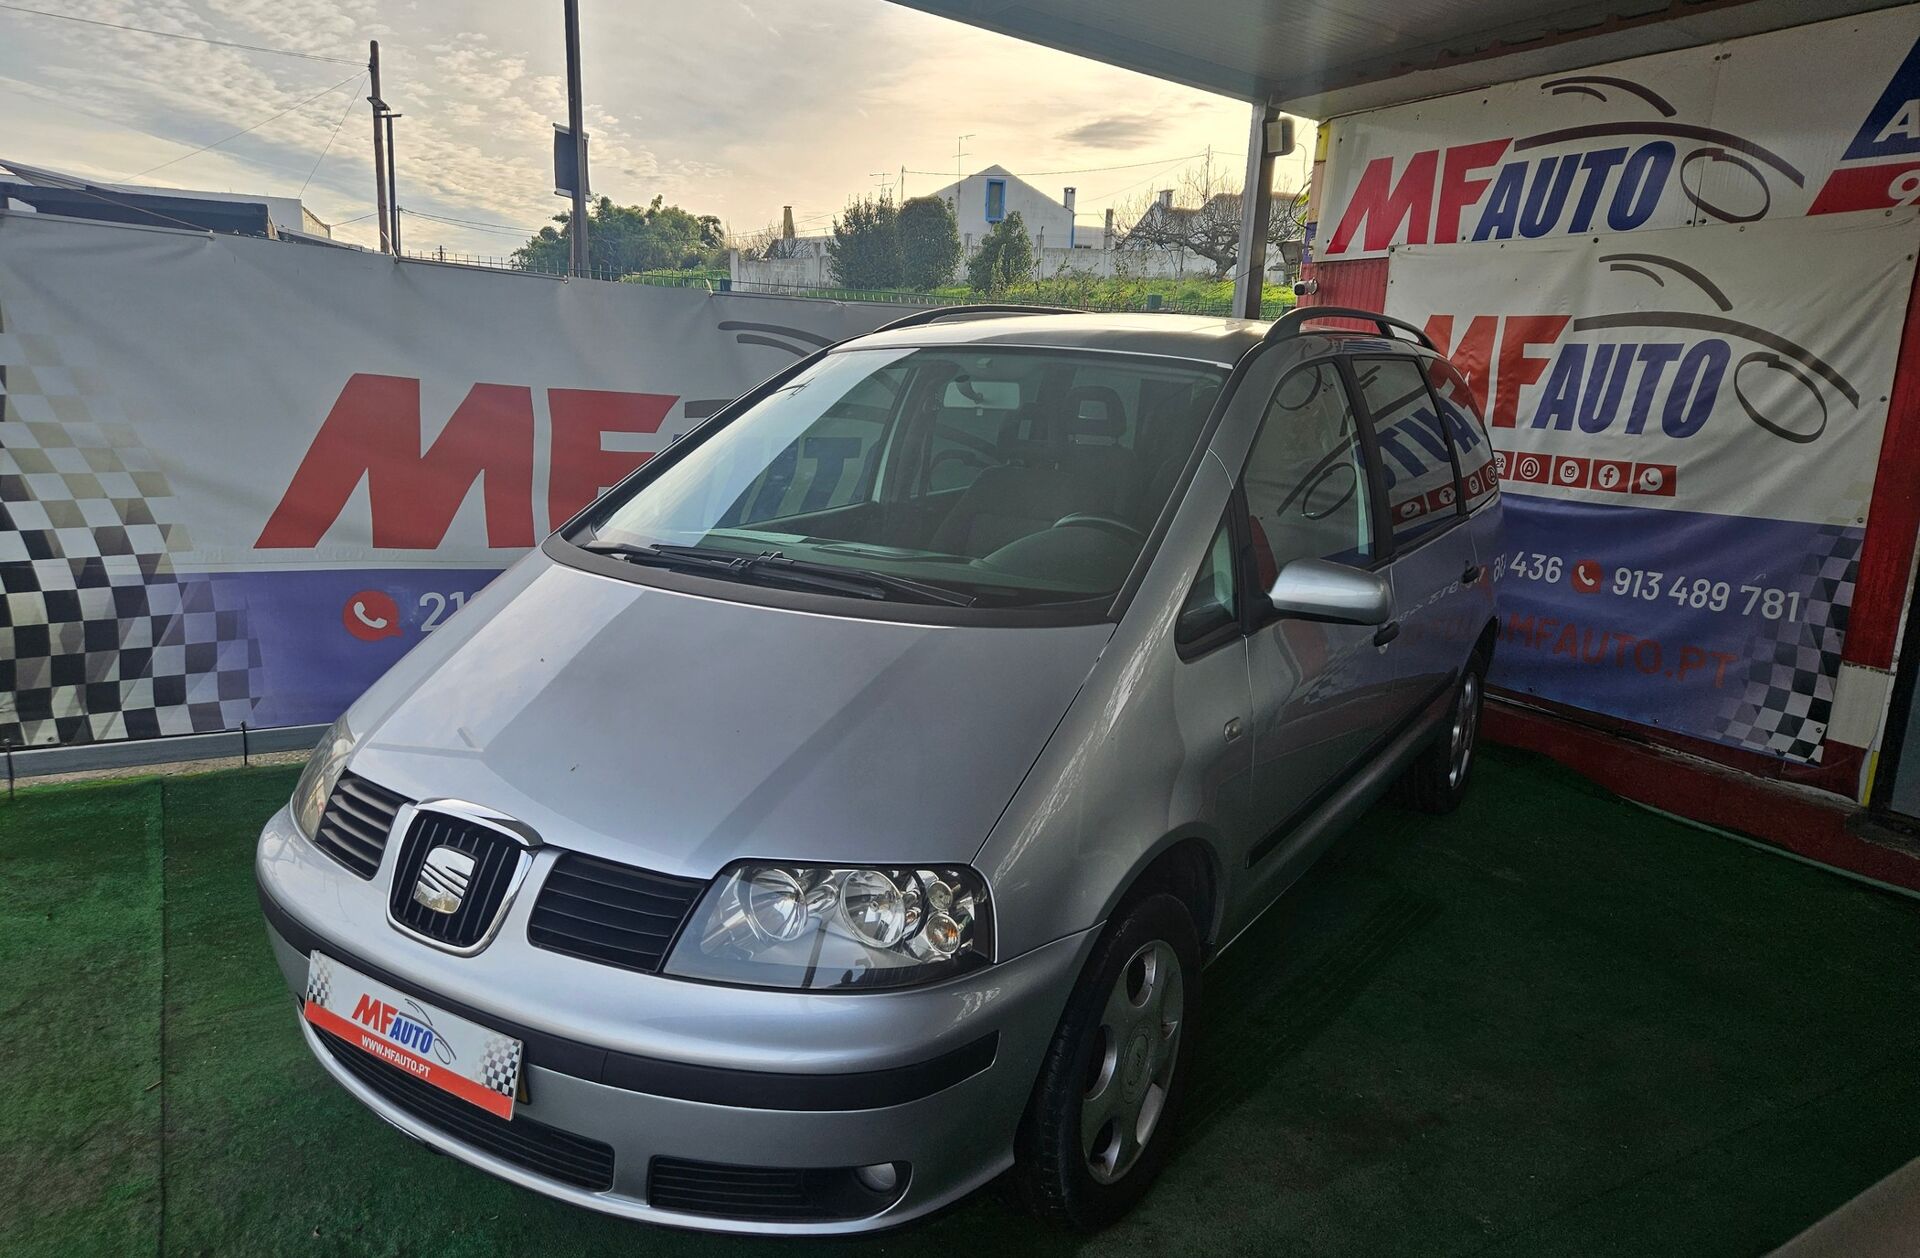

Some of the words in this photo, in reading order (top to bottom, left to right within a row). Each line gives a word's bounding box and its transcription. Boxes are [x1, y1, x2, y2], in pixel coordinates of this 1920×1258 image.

[1510, 551, 1563, 583] 436
[1613, 567, 1664, 601] 913
[1668, 576, 1731, 612] 489
[1740, 584, 1801, 623] 781
[361, 1034, 431, 1078] WWW.MFAUTO.PT
